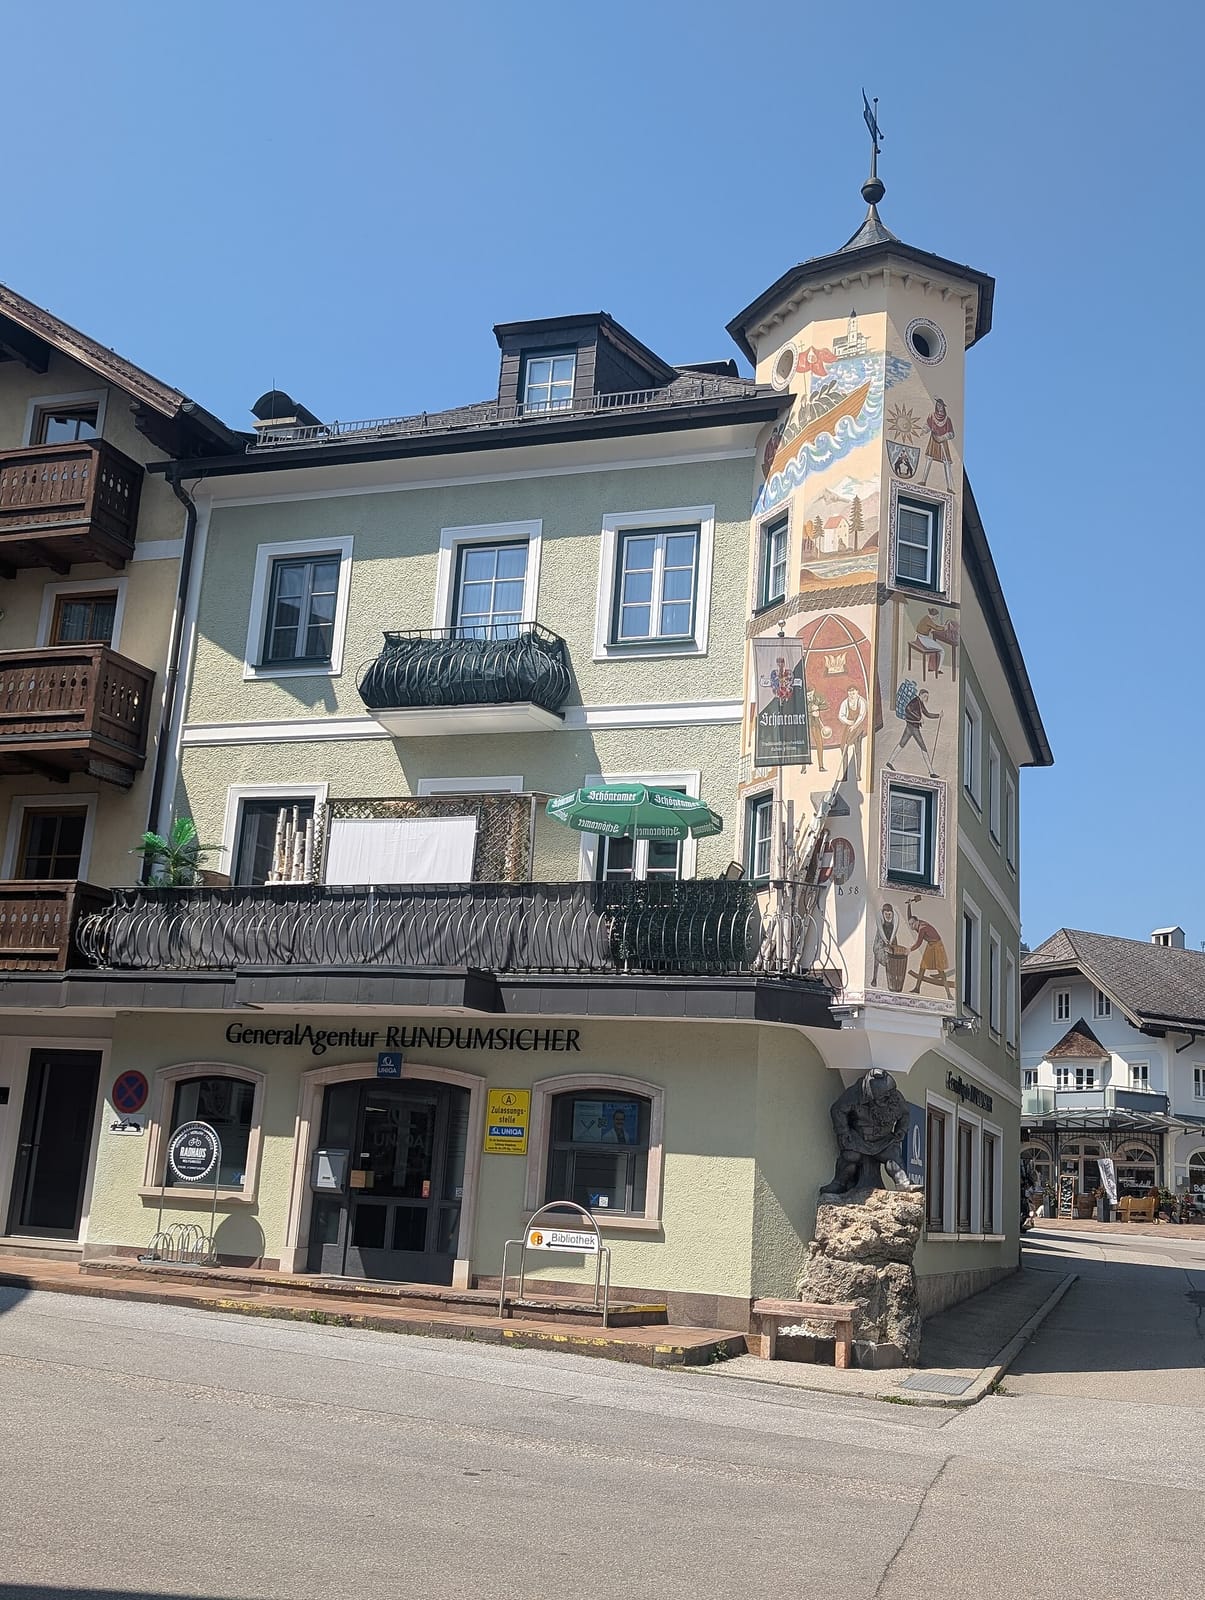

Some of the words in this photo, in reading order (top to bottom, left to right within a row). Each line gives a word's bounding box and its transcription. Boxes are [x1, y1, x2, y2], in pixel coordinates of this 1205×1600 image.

[225, 1022, 379, 1055] GeneralAgentur
[385, 1025, 582, 1052] RUNDUMSICHER
[491, 1106, 527, 1116] Zulassungs-
[499, 1115, 516, 1124] stelle
[500, 1128, 523, 1136] UNIQA
[180, 1147, 206, 1158] RADHAUS
[551, 1233, 595, 1245] Bibliothek
